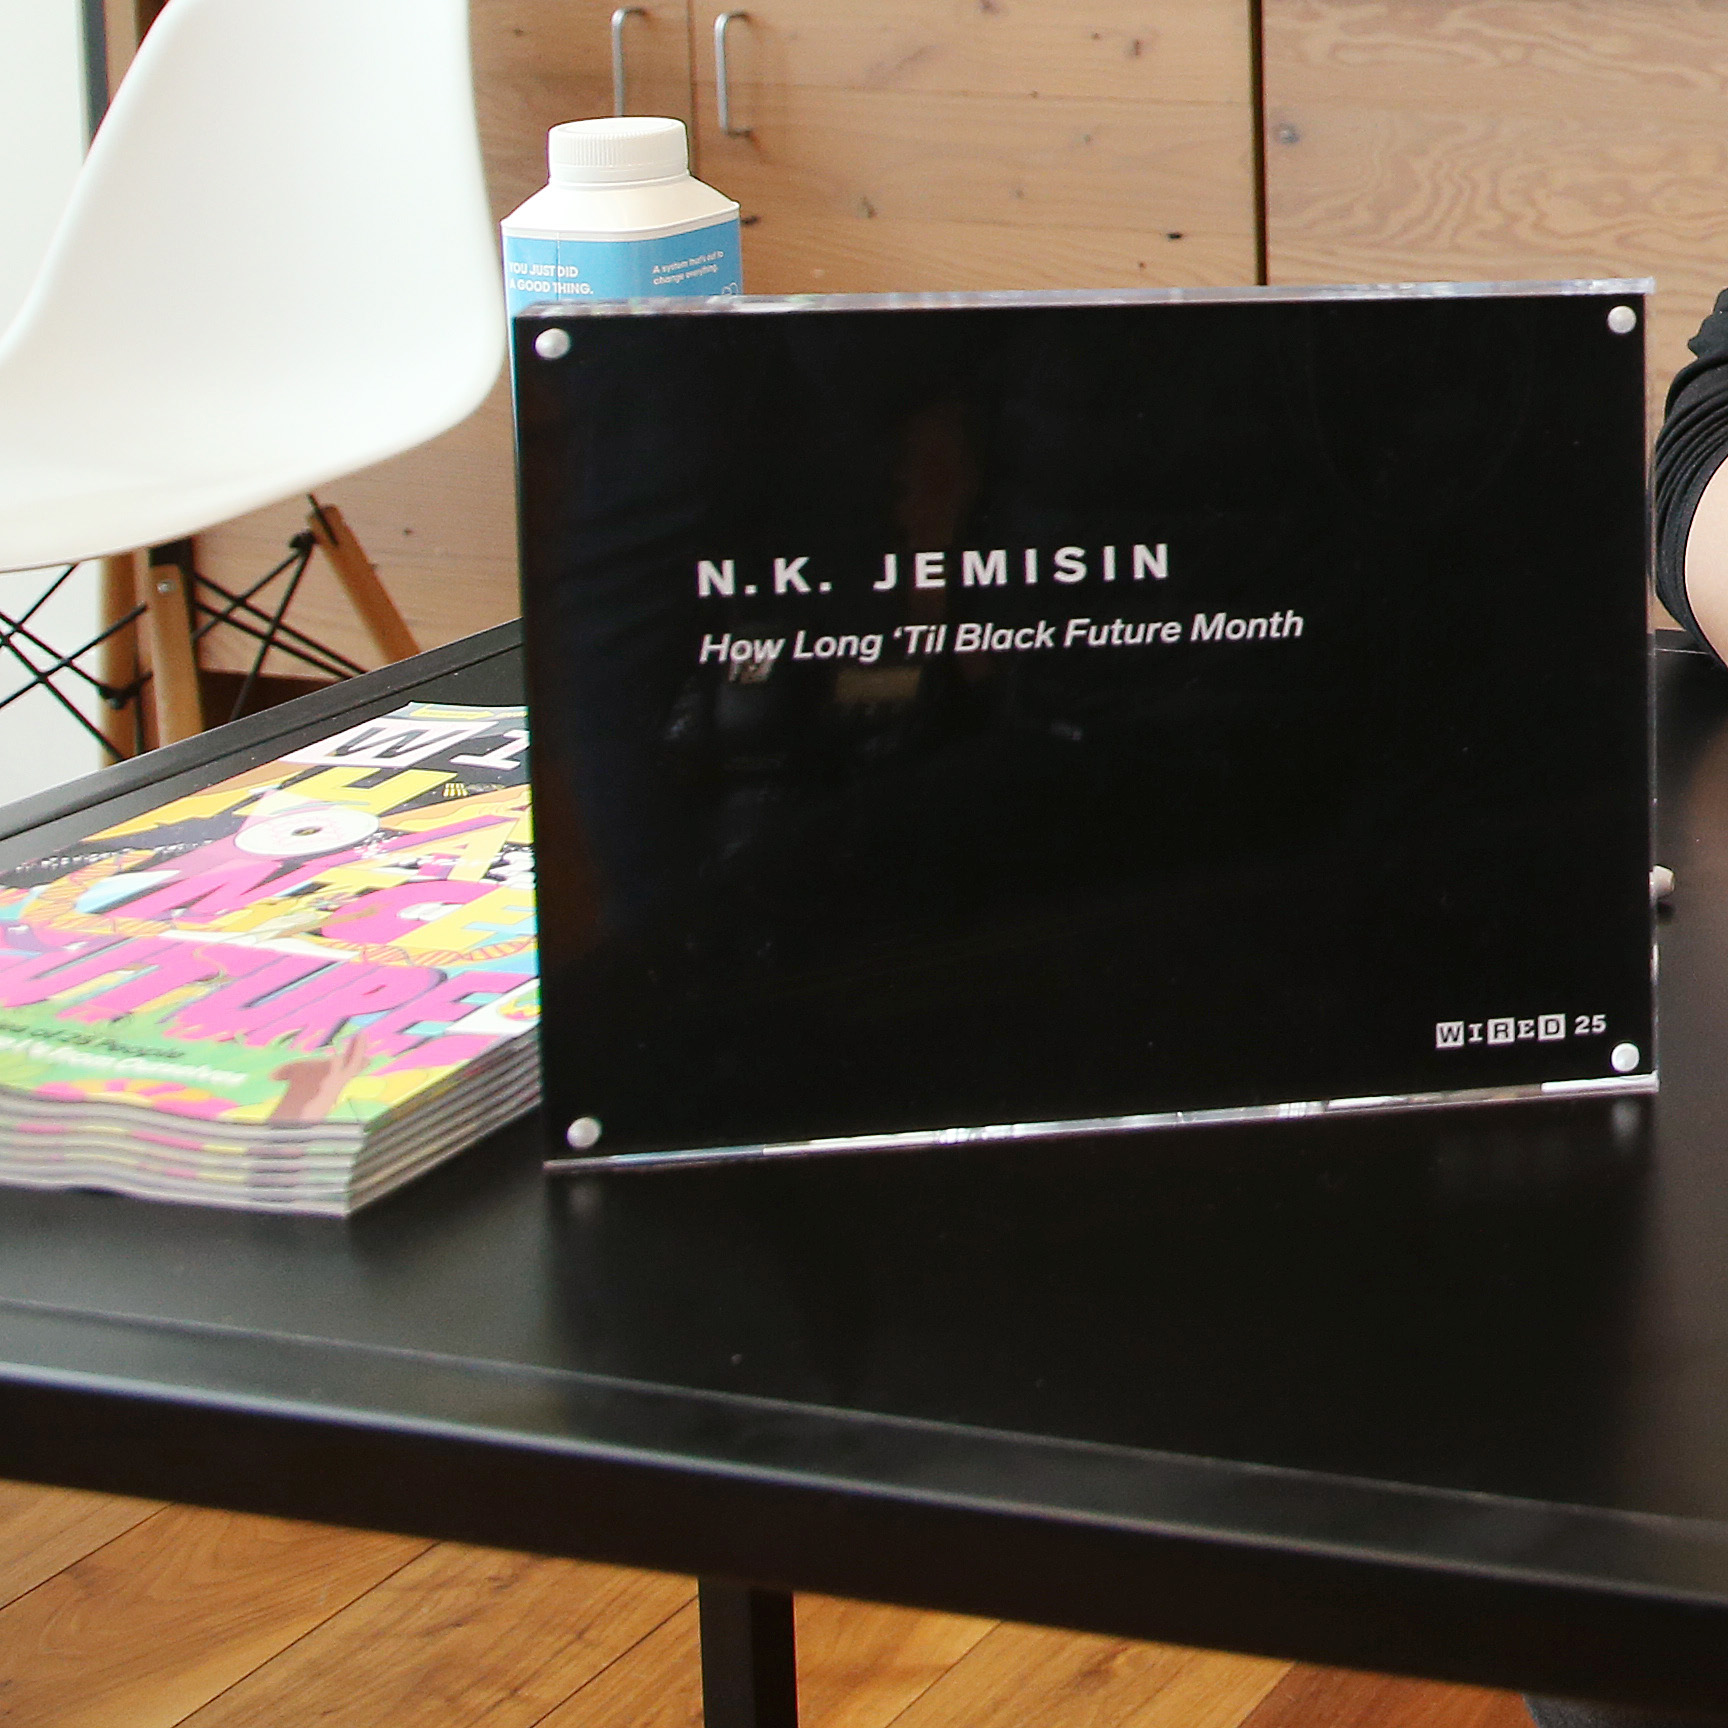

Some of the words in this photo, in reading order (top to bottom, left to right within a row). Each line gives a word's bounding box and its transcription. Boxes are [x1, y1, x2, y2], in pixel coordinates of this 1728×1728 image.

[509, 262, 527, 274] YOU
[529, 263, 556, 276] JUST
[557, 265, 578, 278] DID
[510, 278, 516, 289] A
[517, 279, 549, 292] GOOD
[553, 282, 594, 295] THING.
[697, 557, 832, 597] N.K.
[872, 542, 1170, 592] JEMISIN
[699, 634, 784, 664] How
[793, 630, 882, 662] Long
[893, 625, 945, 655] 'Til
[954, 620, 1055, 653] Black
[1063, 617, 1182, 647] Future
[1190, 609, 1303, 643] Month
[1436, 1013, 1565, 1048] WIRED
[1575, 1013, 1607, 1036] 25
